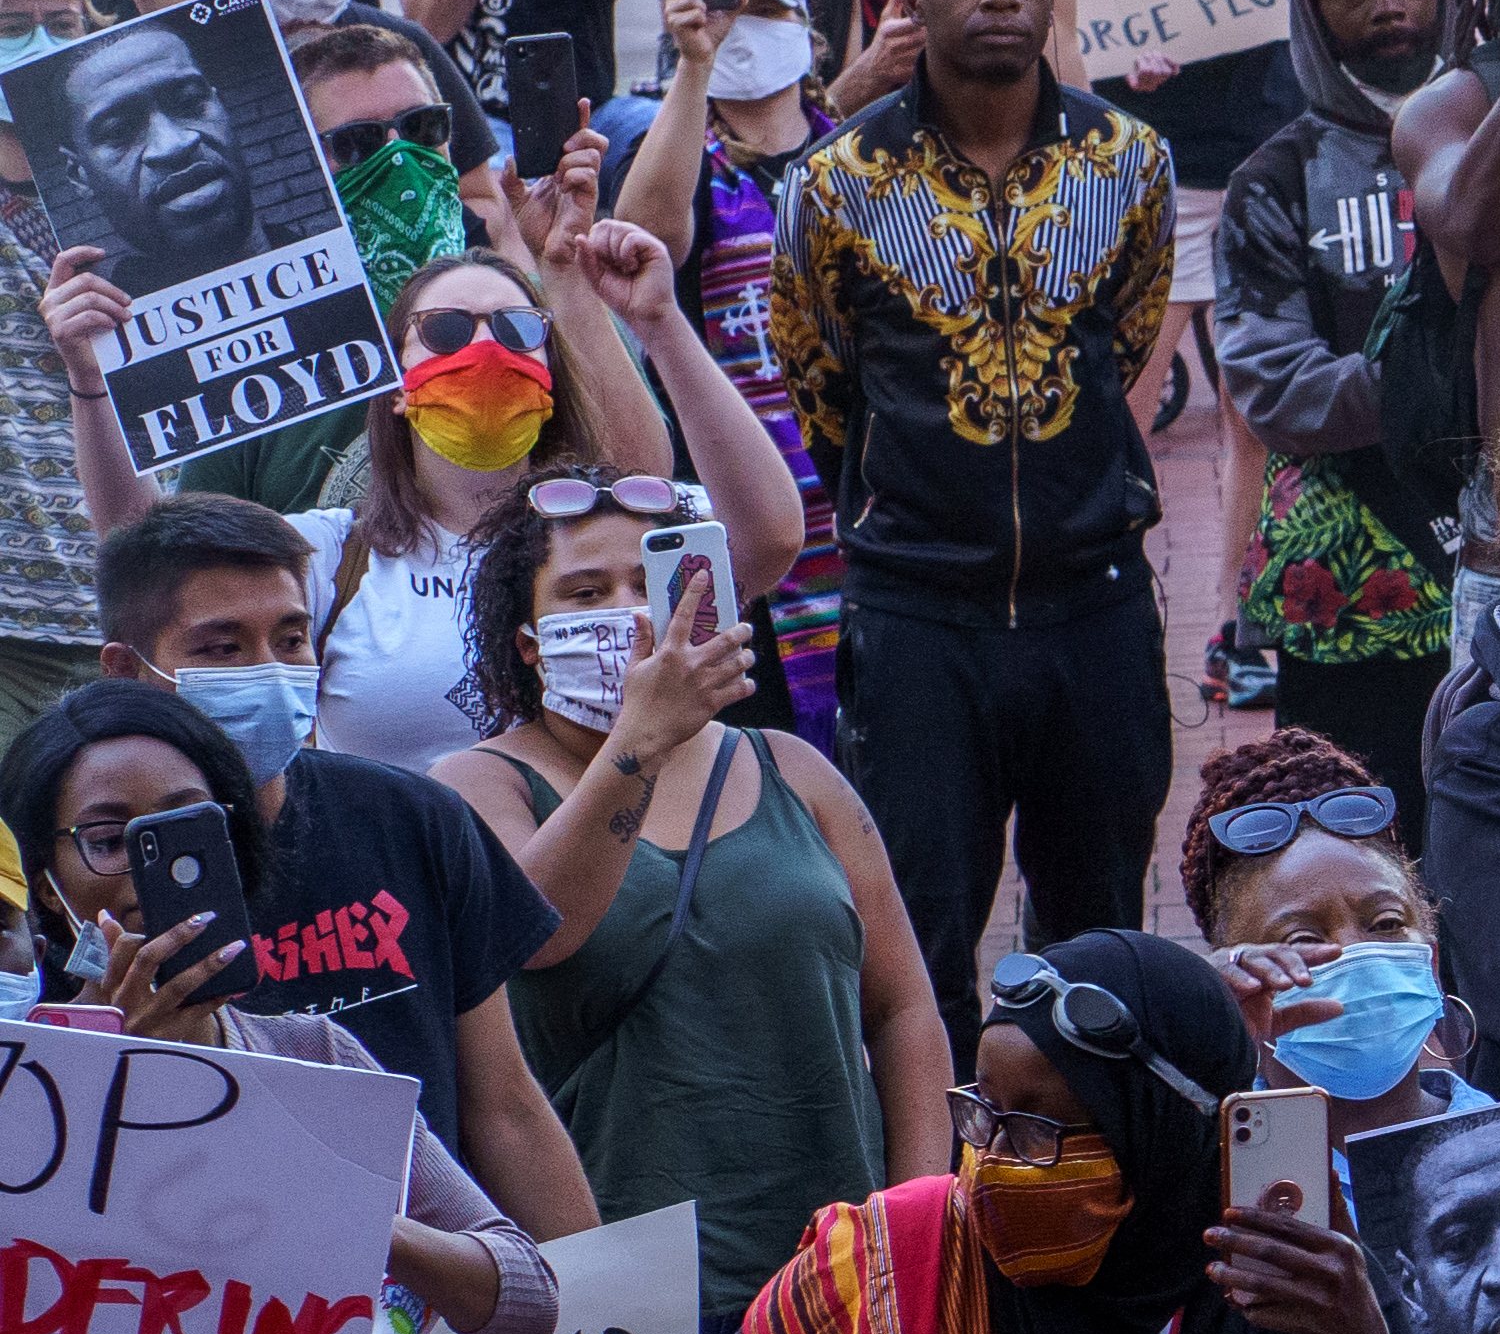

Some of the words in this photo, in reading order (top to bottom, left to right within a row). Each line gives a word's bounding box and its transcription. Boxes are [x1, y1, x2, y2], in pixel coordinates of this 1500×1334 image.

[1077, 2, 1182, 55] ORGE
[115, 246, 340, 369] JUSTICE
[205, 327, 280, 370] FOR
[138, 339, 385, 462] FLOYD
[595, 623, 637, 653] BLA
[600, 652, 632, 677] LIV
[0, 1042, 240, 1216] OP
